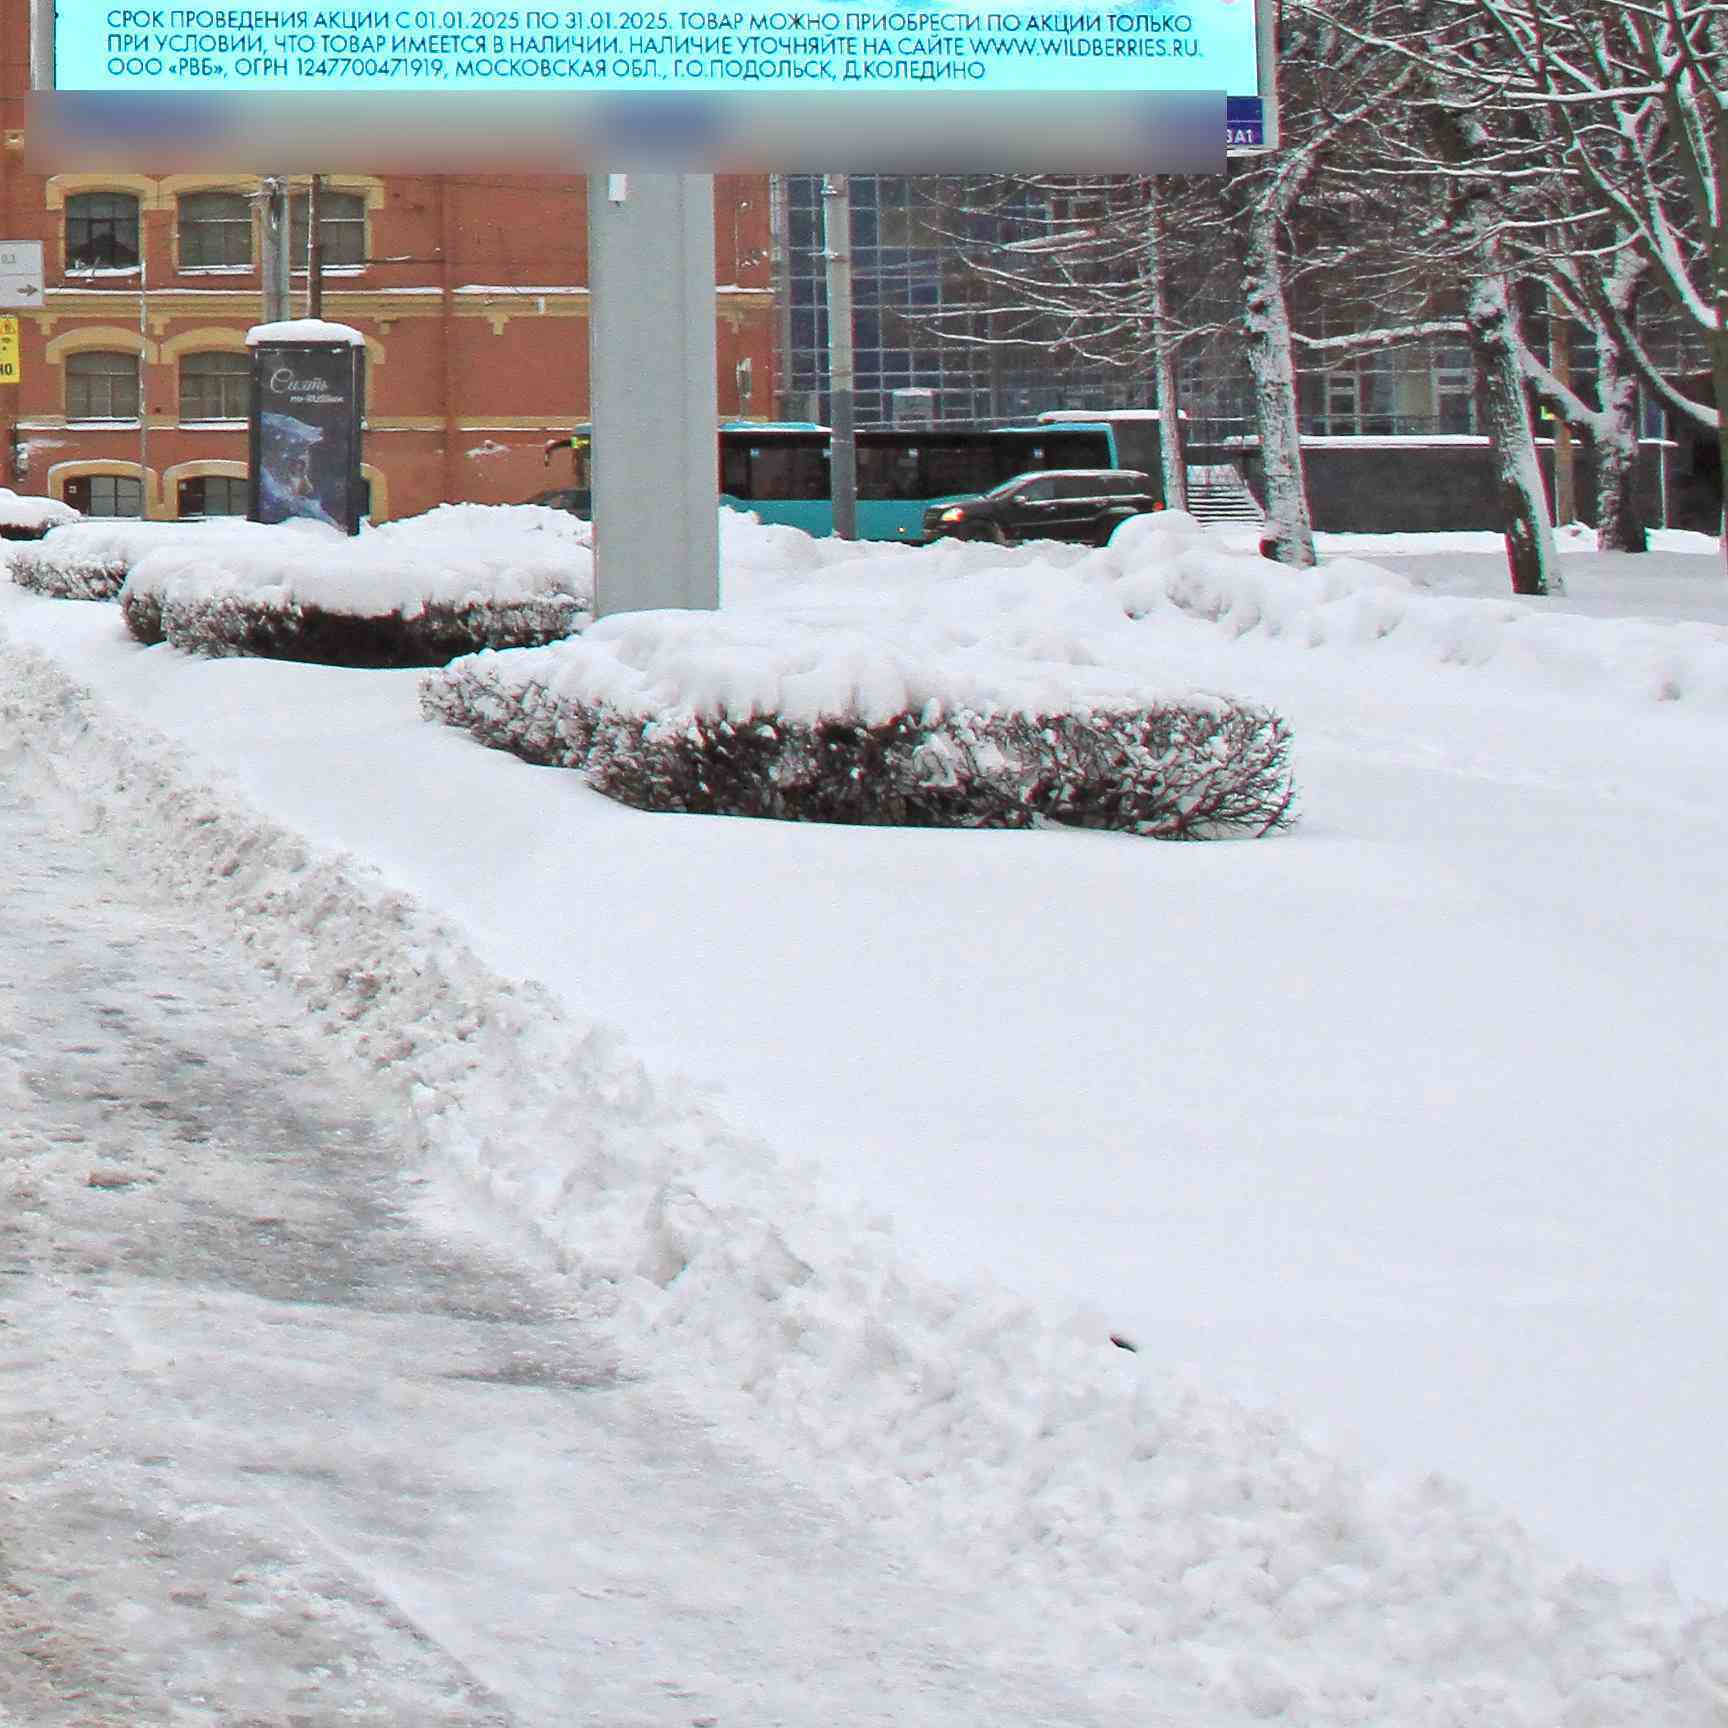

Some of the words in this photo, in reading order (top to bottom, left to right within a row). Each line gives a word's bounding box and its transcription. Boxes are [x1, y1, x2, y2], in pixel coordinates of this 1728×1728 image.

[106, 11, 165, 29] СРОК
[170, 11, 309, 32] ПРОВЕДЕНИЯ
[314, 11, 389, 32] АКЦИИ
[395, 11, 410, 30] С
[414, 12, 519, 30] 01.01.2025
[526, 12, 559, 30] ПО
[680, 12, 744, 31] ТОВАР
[749, 13, 840, 31] МОЖНО
[846, 13, 980, 31] ПРИОБРЕСТИ
[988, 13, 1021, 32] ПО
[1026, 14, 1100, 35] АКЦИИ
[1108, 14, 1192, 32] ТОЛЬКО
[107, 34, 148, 53] ПРИ
[275, 35, 315, 54] ЧТО
[321, 35, 385, 54] ТОВАР
[391, 35, 485, 54] ИМЕЕТСЯ
[493, 35, 505, 54] В
[630, 36, 733, 55] НАЛИЧИЕ
[738, 34, 858, 56] УТОЧНЯЙТЕ
[864, 37, 891, 56] НА
[897, 34, 965, 56] САЙТЕ
[107, 58, 162, 76] ООО
[234, 58, 288, 77] ОГРН
[455, 59, 606, 78] МОСКОВСКАЯ
